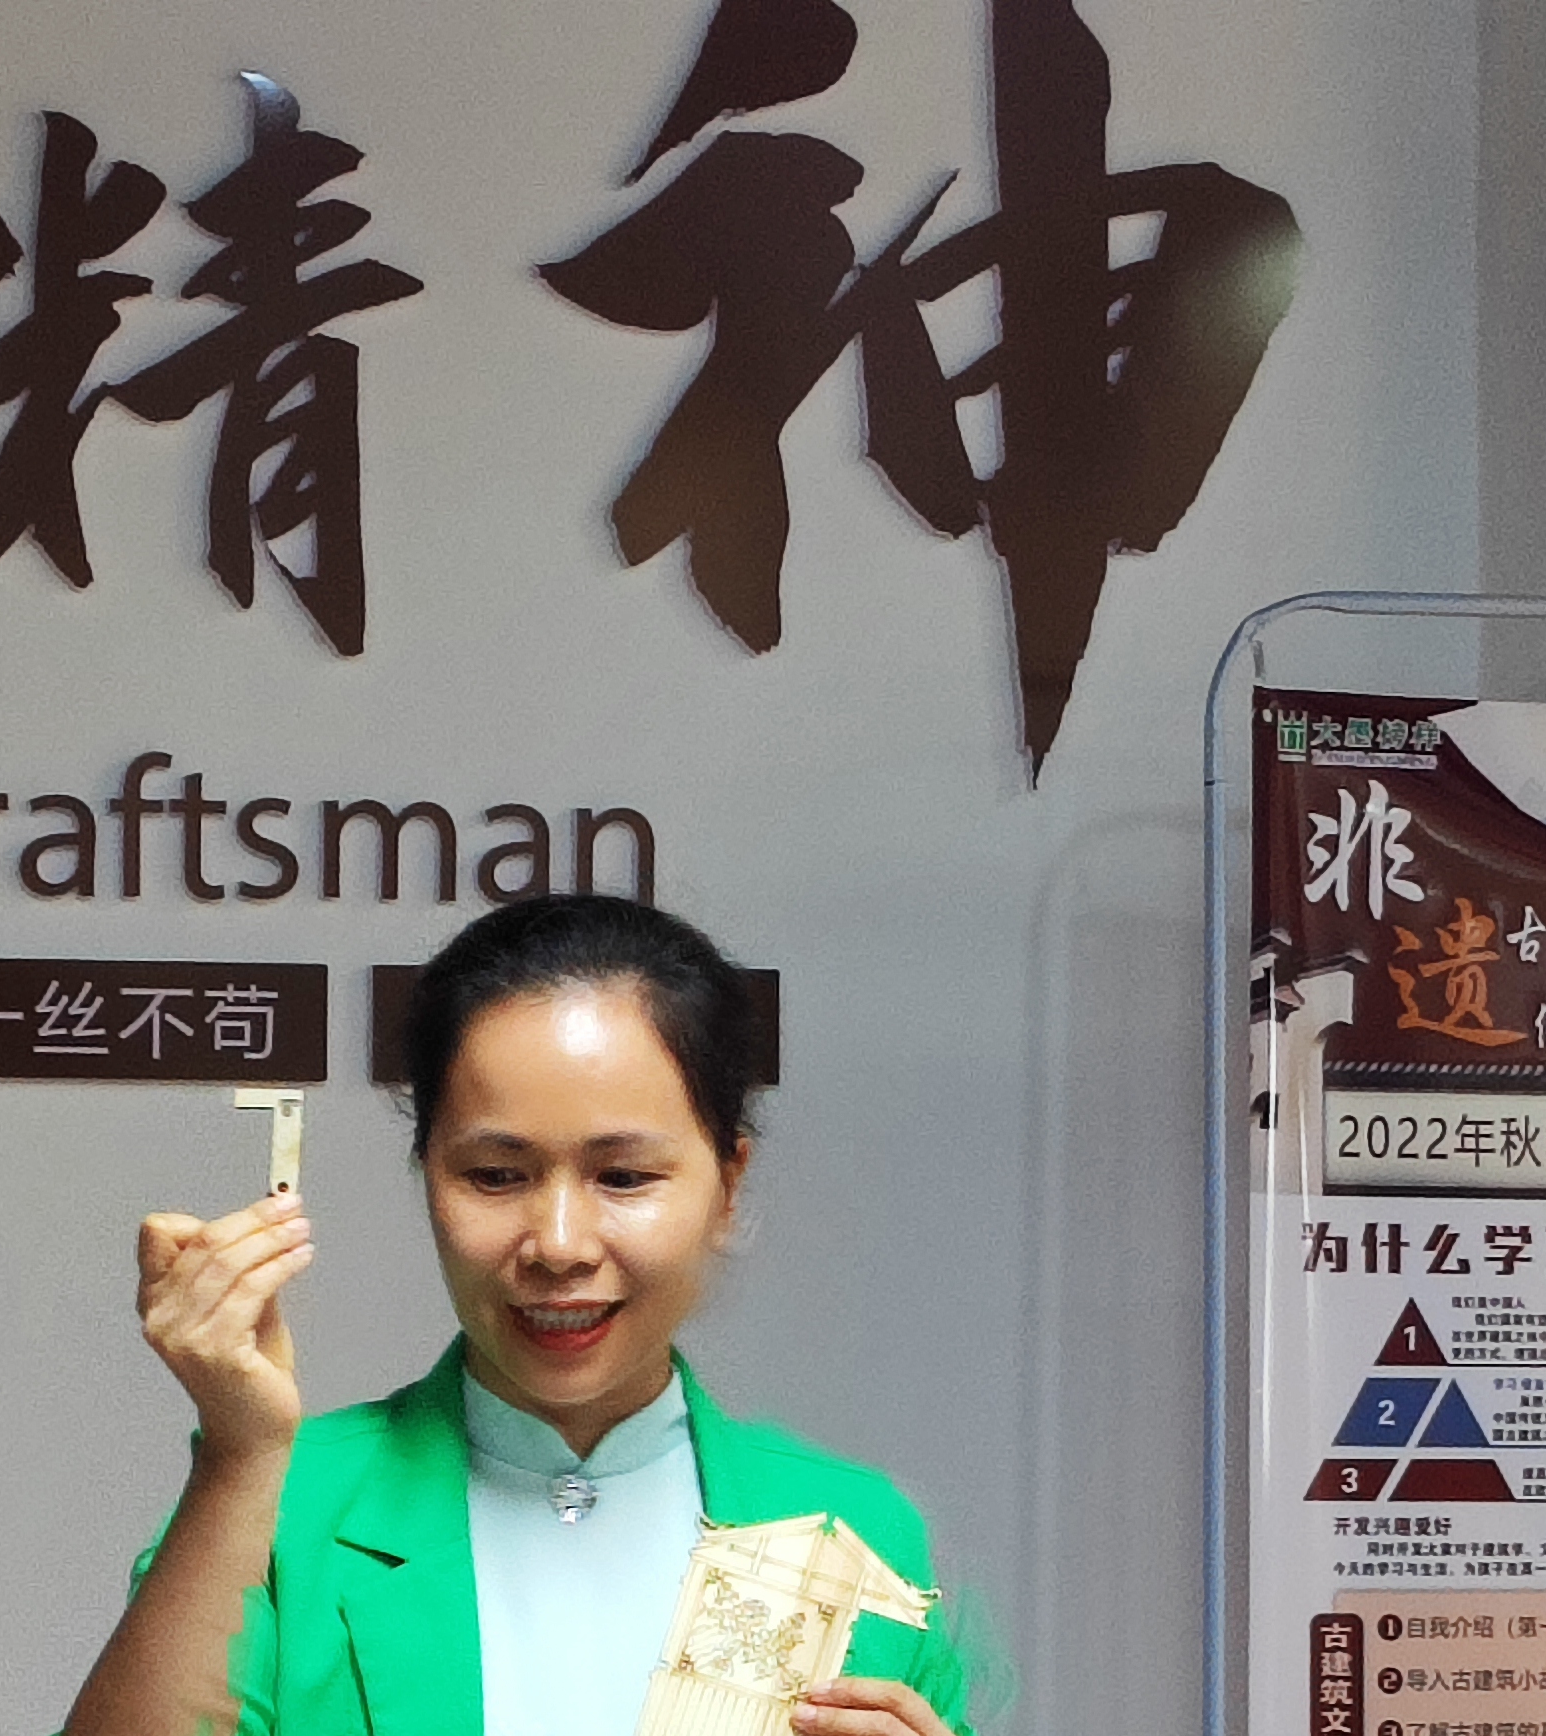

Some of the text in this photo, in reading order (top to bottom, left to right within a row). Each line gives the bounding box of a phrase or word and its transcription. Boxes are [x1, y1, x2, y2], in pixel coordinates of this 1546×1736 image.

[1403, 1326, 1417, 1350] 1
[1377, 1400, 1396, 1425] 2
[1340, 1468, 1358, 1494] 3
[1333, 1517, 1452, 1536] 开发兴趣爱好
